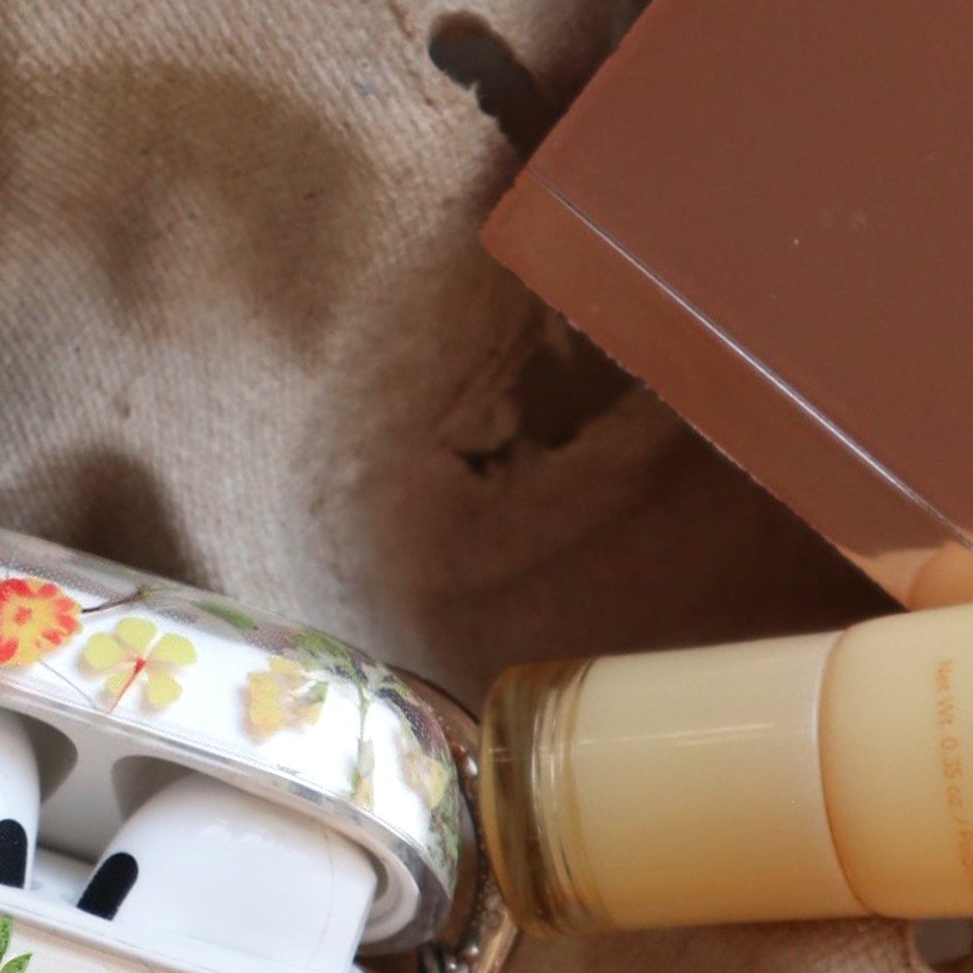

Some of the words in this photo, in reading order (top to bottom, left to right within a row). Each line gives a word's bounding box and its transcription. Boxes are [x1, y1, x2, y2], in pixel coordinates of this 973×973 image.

[936, 658, 954, 690] Net
[940, 736, 964, 780] 0.35
[947, 784, 964, 809] oz
